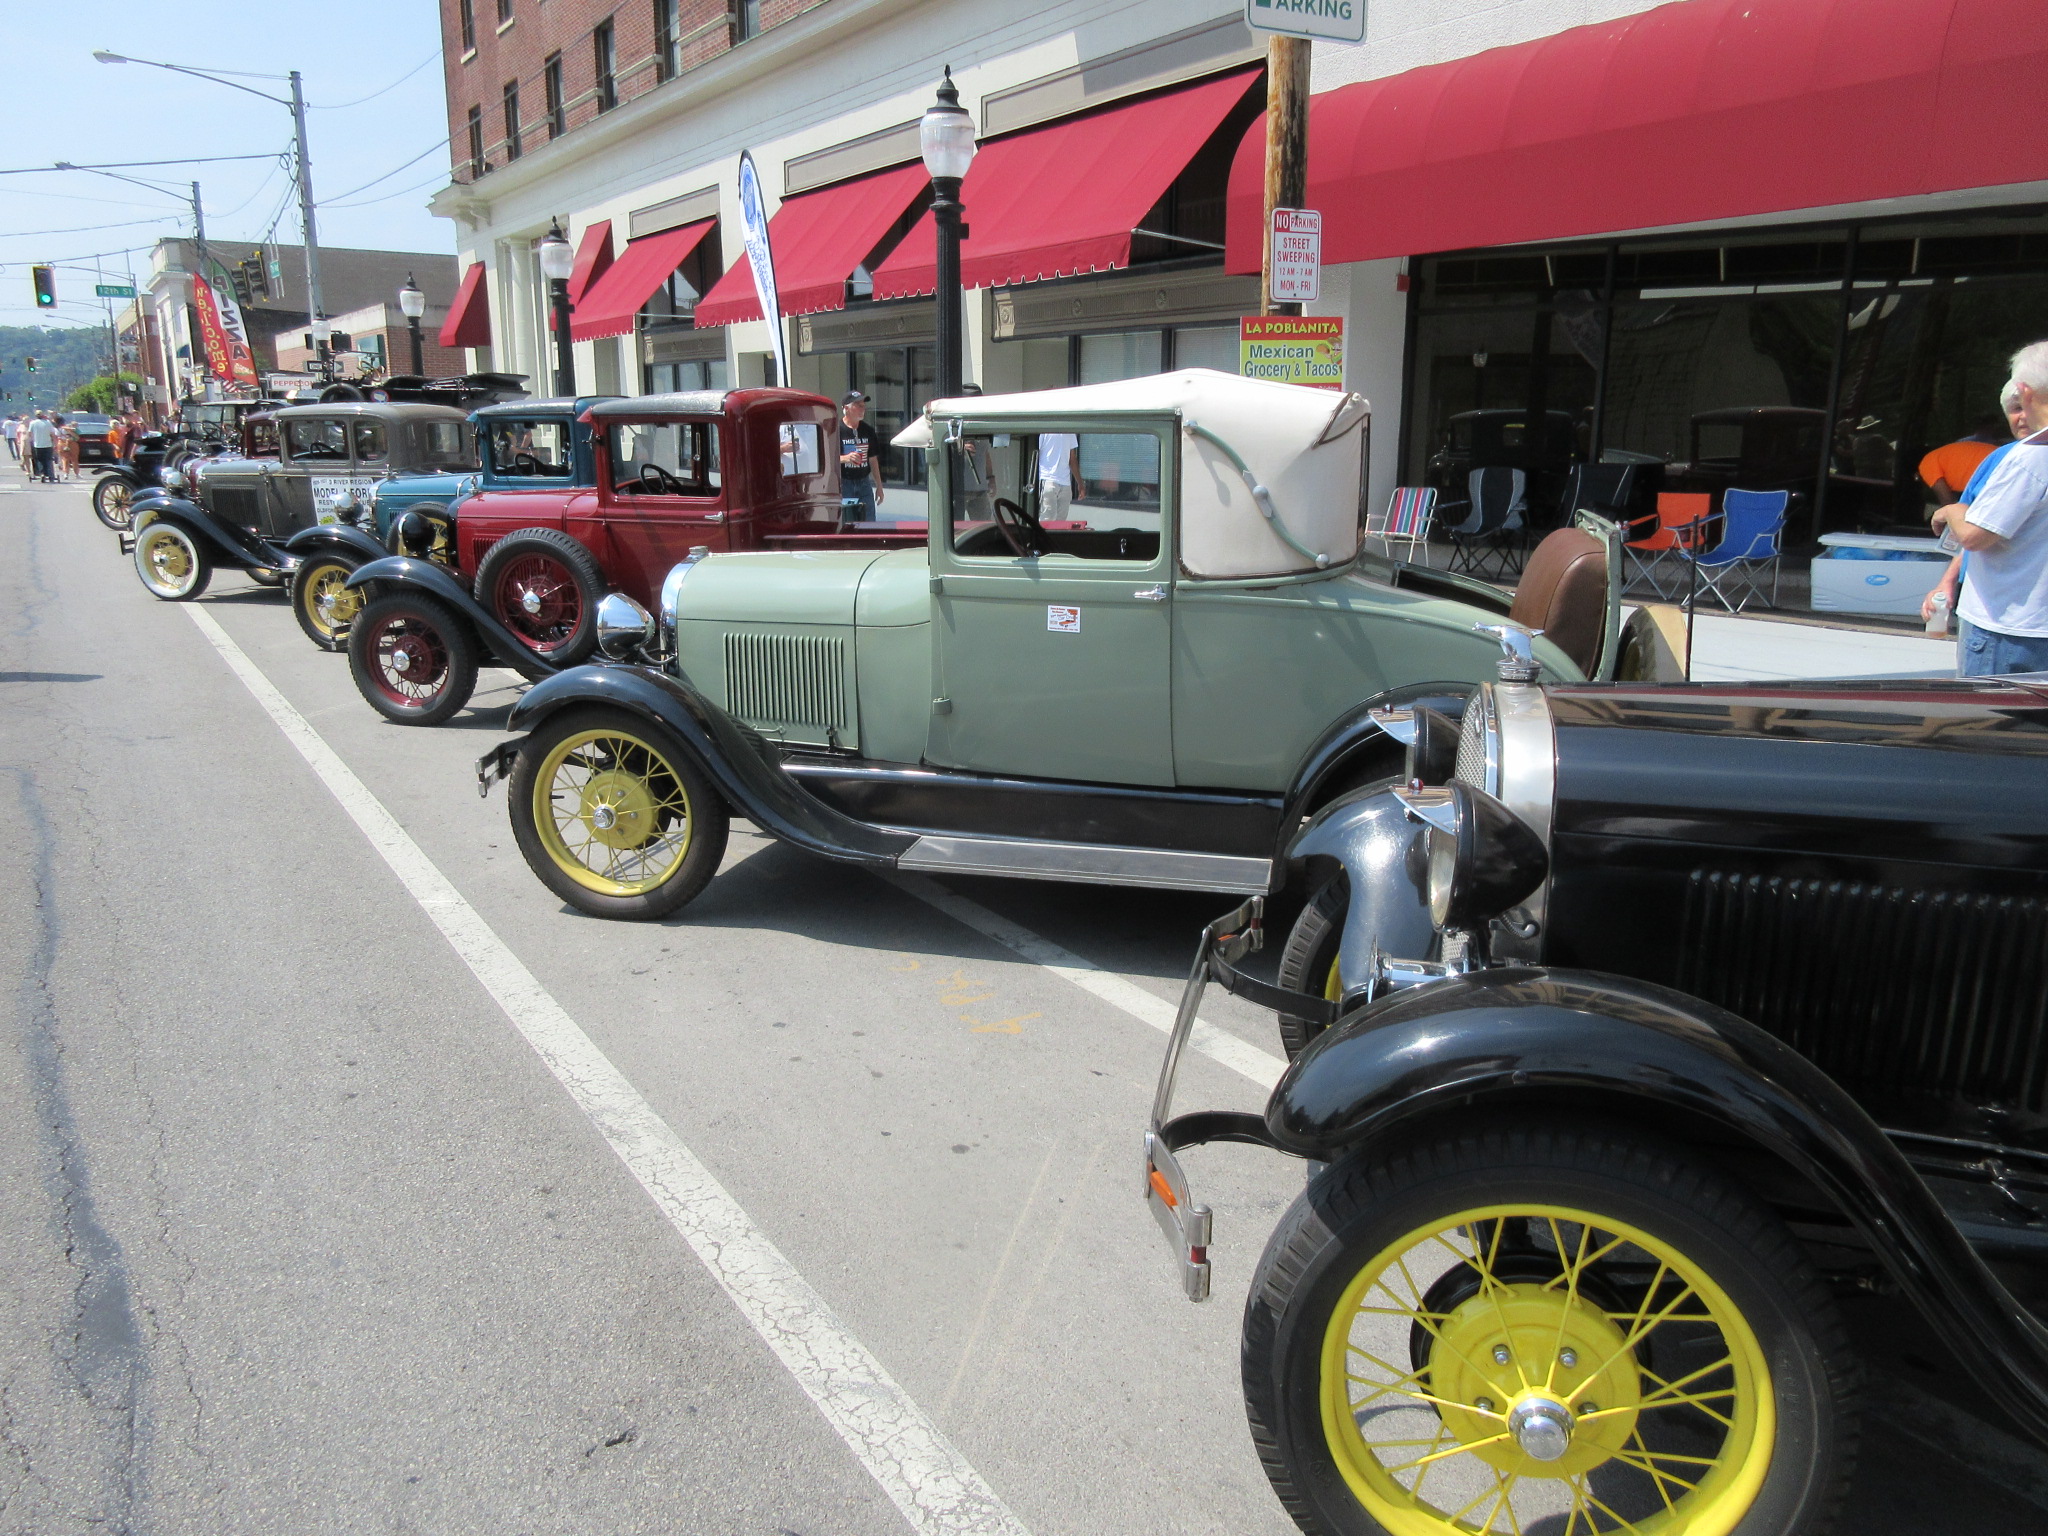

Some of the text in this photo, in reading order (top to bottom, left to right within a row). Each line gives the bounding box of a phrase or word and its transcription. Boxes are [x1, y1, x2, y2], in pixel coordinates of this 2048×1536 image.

[1256, 0, 1352, 20] ARKING
[1276, 214, 1318, 229] NO PARKING
[1283, 237, 1310, 250] STREET
[1277, 250, 1315, 263] SWEEPING
[1280, 267, 1285, 276] 12
[1287, 267, 1295, 276] AM
[1305, 268, 1312, 276] AM
[100, 286, 120, 295] 12th
[1280, 280, 1295, 290] MON
[1301, 280, 1311, 291] FRI
[1245, 322, 1339, 334] LA POBLANITA
[1249, 344, 1314, 358] Mexican
[1244, 360, 1338, 380] Grocery & Tacos
[351, 488, 370, 498] FOR
